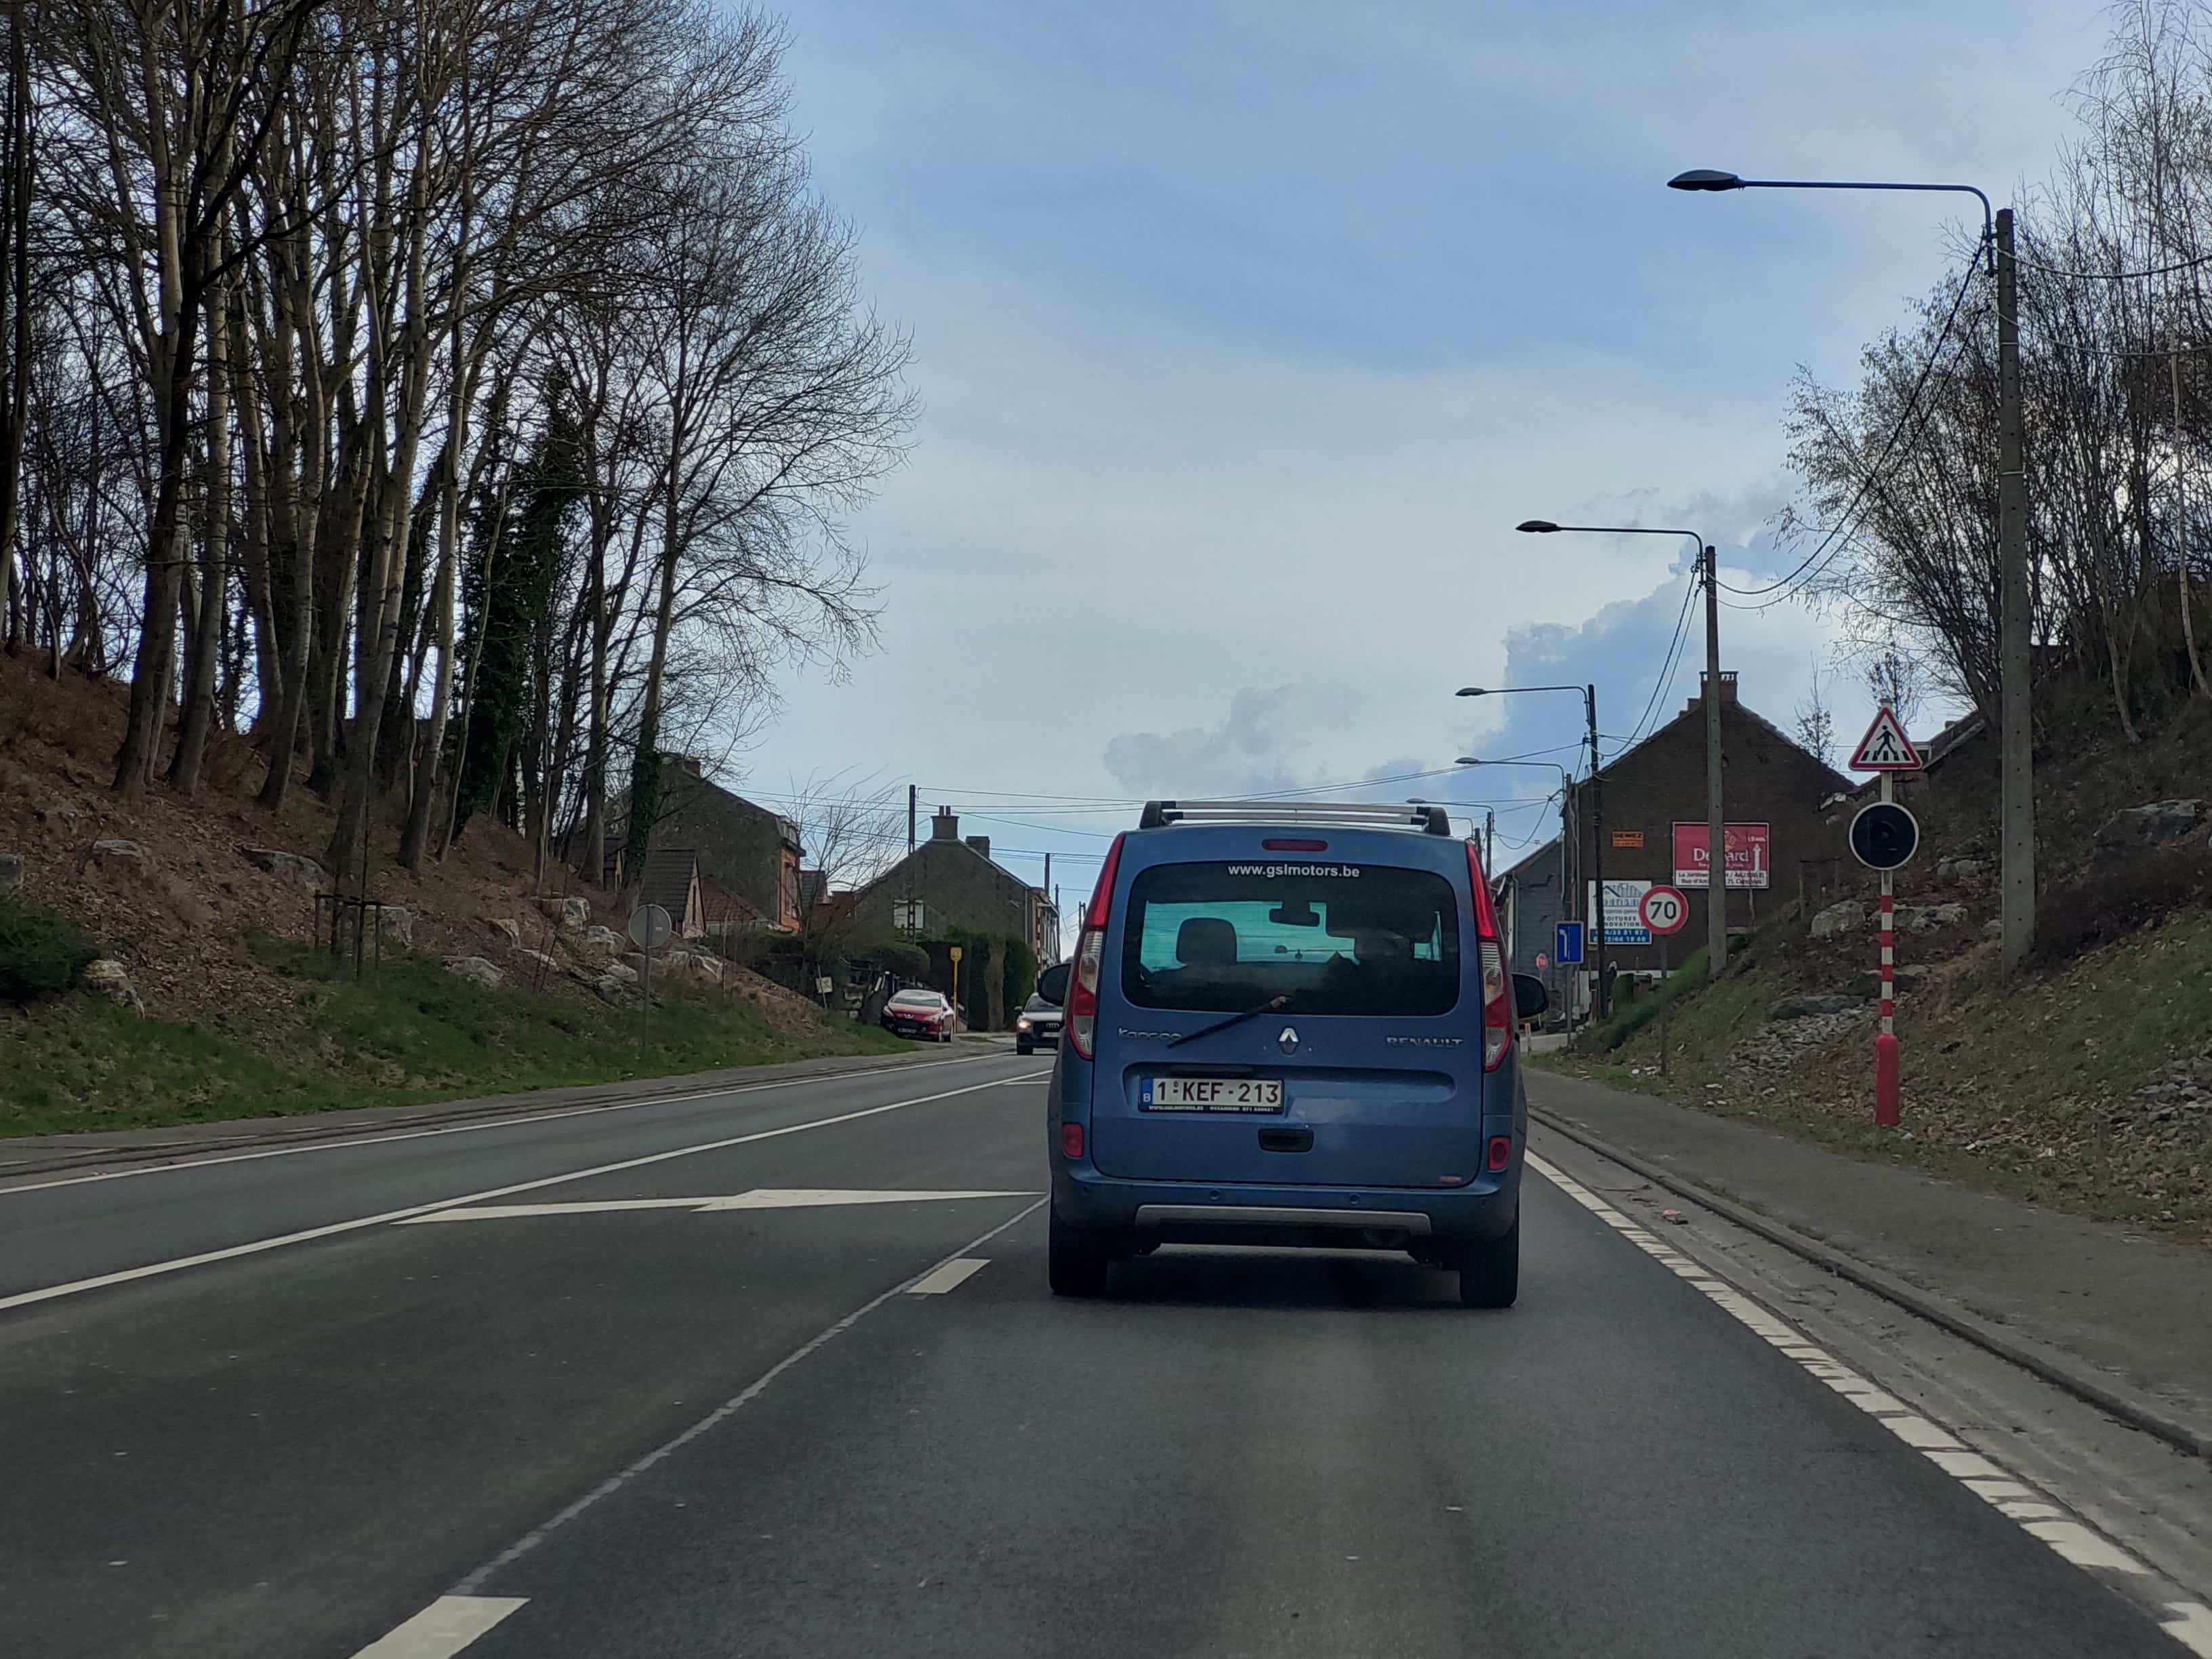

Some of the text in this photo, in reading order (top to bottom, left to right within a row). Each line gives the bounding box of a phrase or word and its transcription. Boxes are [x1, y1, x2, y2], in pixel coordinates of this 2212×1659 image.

[1227, 863, 1360, 878] www.gslmotors.be
[1650, 901, 1677, 920] 70
[1386, 1036, 1465, 1048] RENAULT
